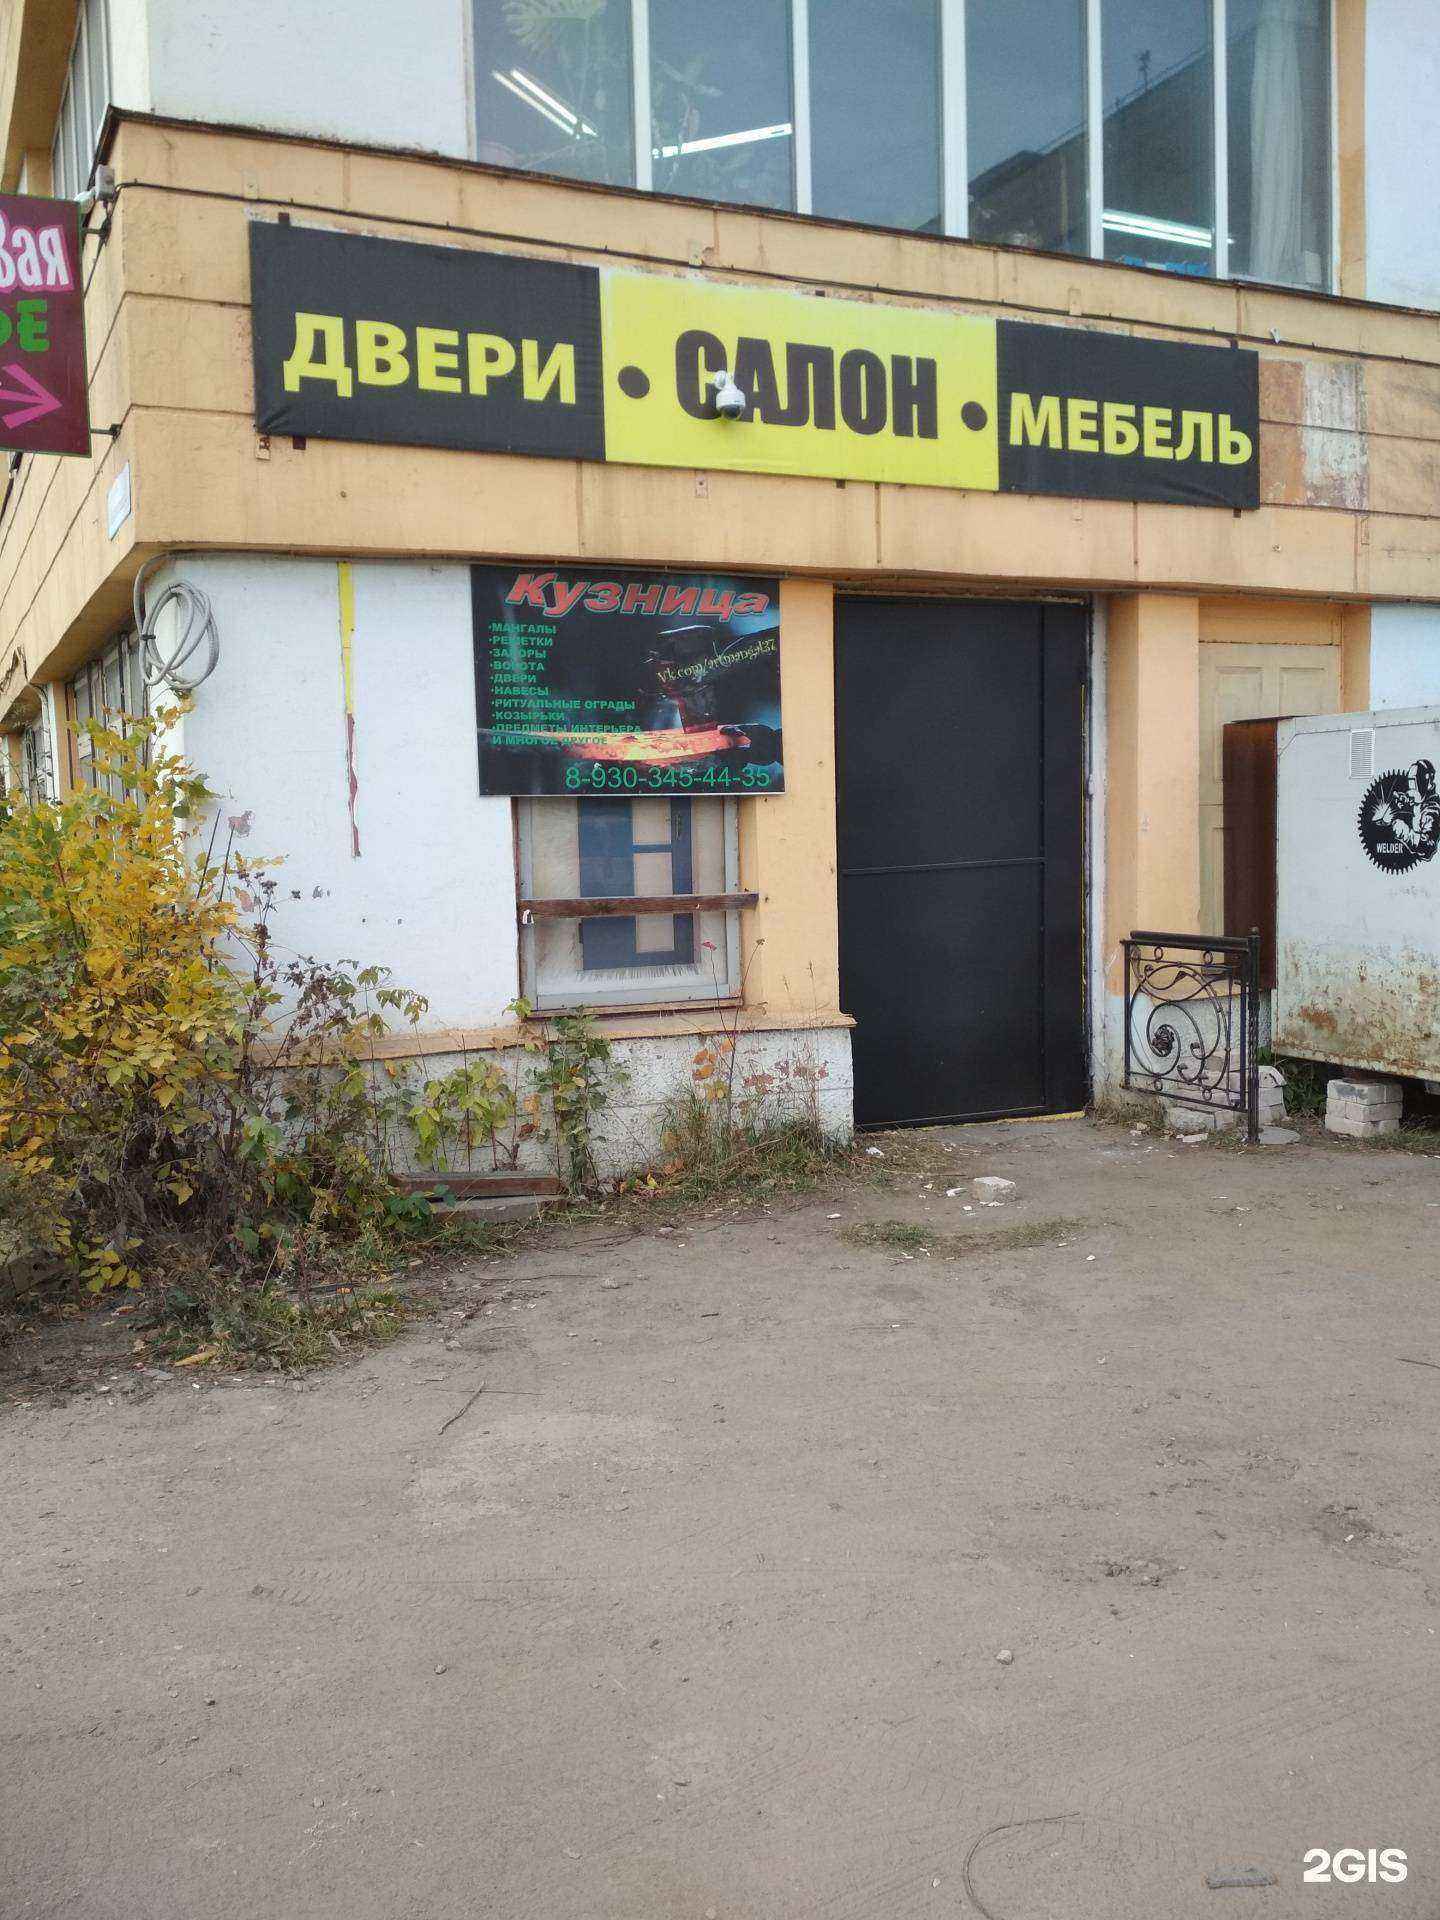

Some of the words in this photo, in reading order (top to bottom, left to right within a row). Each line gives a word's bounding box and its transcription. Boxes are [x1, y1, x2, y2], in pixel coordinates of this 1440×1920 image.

[282, 311, 577, 405] ДВЕРИ
[675, 328, 939, 440] САЛОН
[1008, 391, 1254, 467] МЕБЕЛЬ
[505, 572, 770, 622] Кузница
[491, 622, 557, 635] МАНГАЛЫ
[493, 673, 537, 684] ДВЕРИ
[494, 686, 549, 696] НАВЕСЫ
[494, 698, 581, 709] РИТУАЛЬНЫЕ
[584, 700, 636, 711] ОГРАДЫ
[495, 711, 565, 721] КОЗЫРЬКИ
[565, 766, 771, 790] 8-930-345-44-35
[1376, 842, 1404, 854] WELDER
